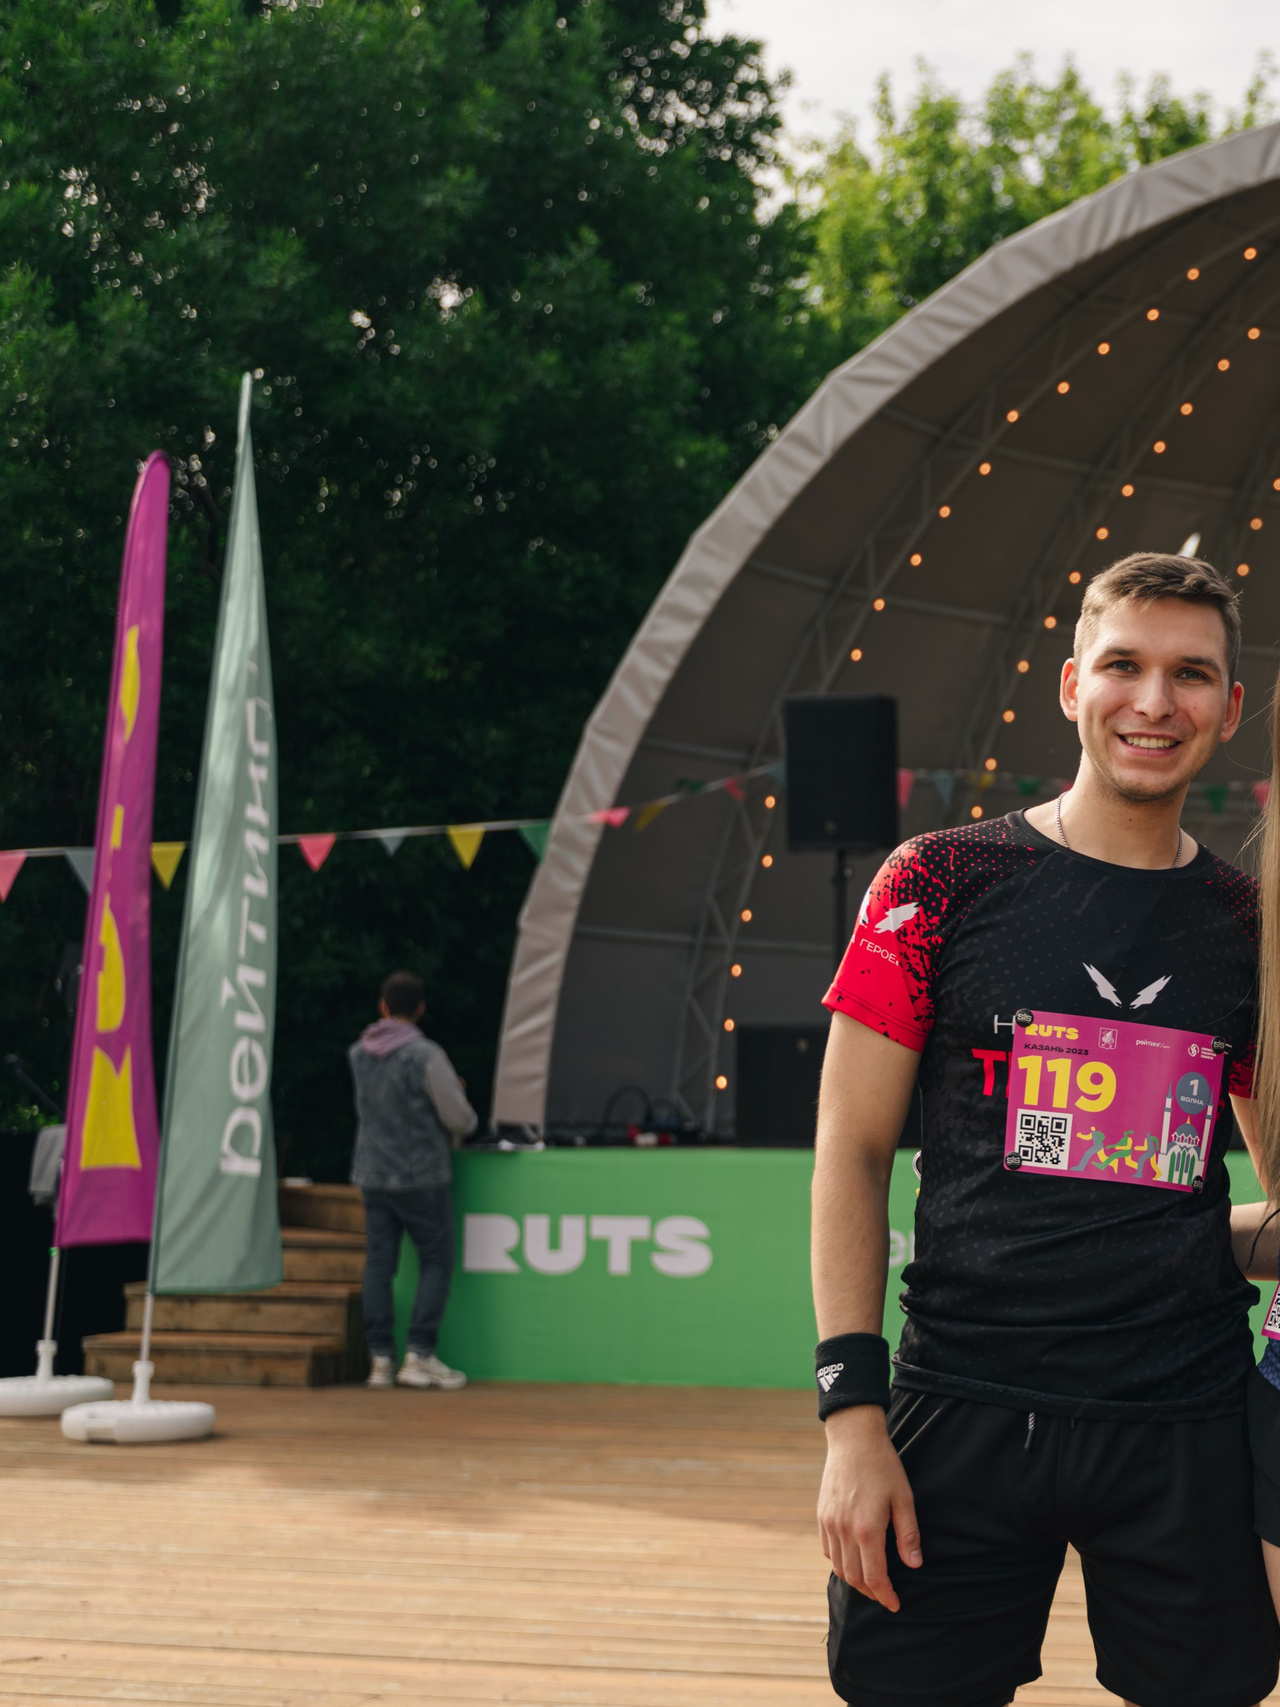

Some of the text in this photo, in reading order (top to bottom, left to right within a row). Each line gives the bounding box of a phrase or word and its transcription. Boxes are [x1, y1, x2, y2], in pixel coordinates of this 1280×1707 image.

[1025, 1023, 1079, 1040] RUTS
[1024, 1043, 1089, 1056] КАЗАНЬ 2023
[1017, 1055, 1117, 1113] 119
[1189, 1079, 1199, 1096] 1
[1180, 1095, 1204, 1106] ВОЛНА
[462, 1213, 714, 1278] RUTS
